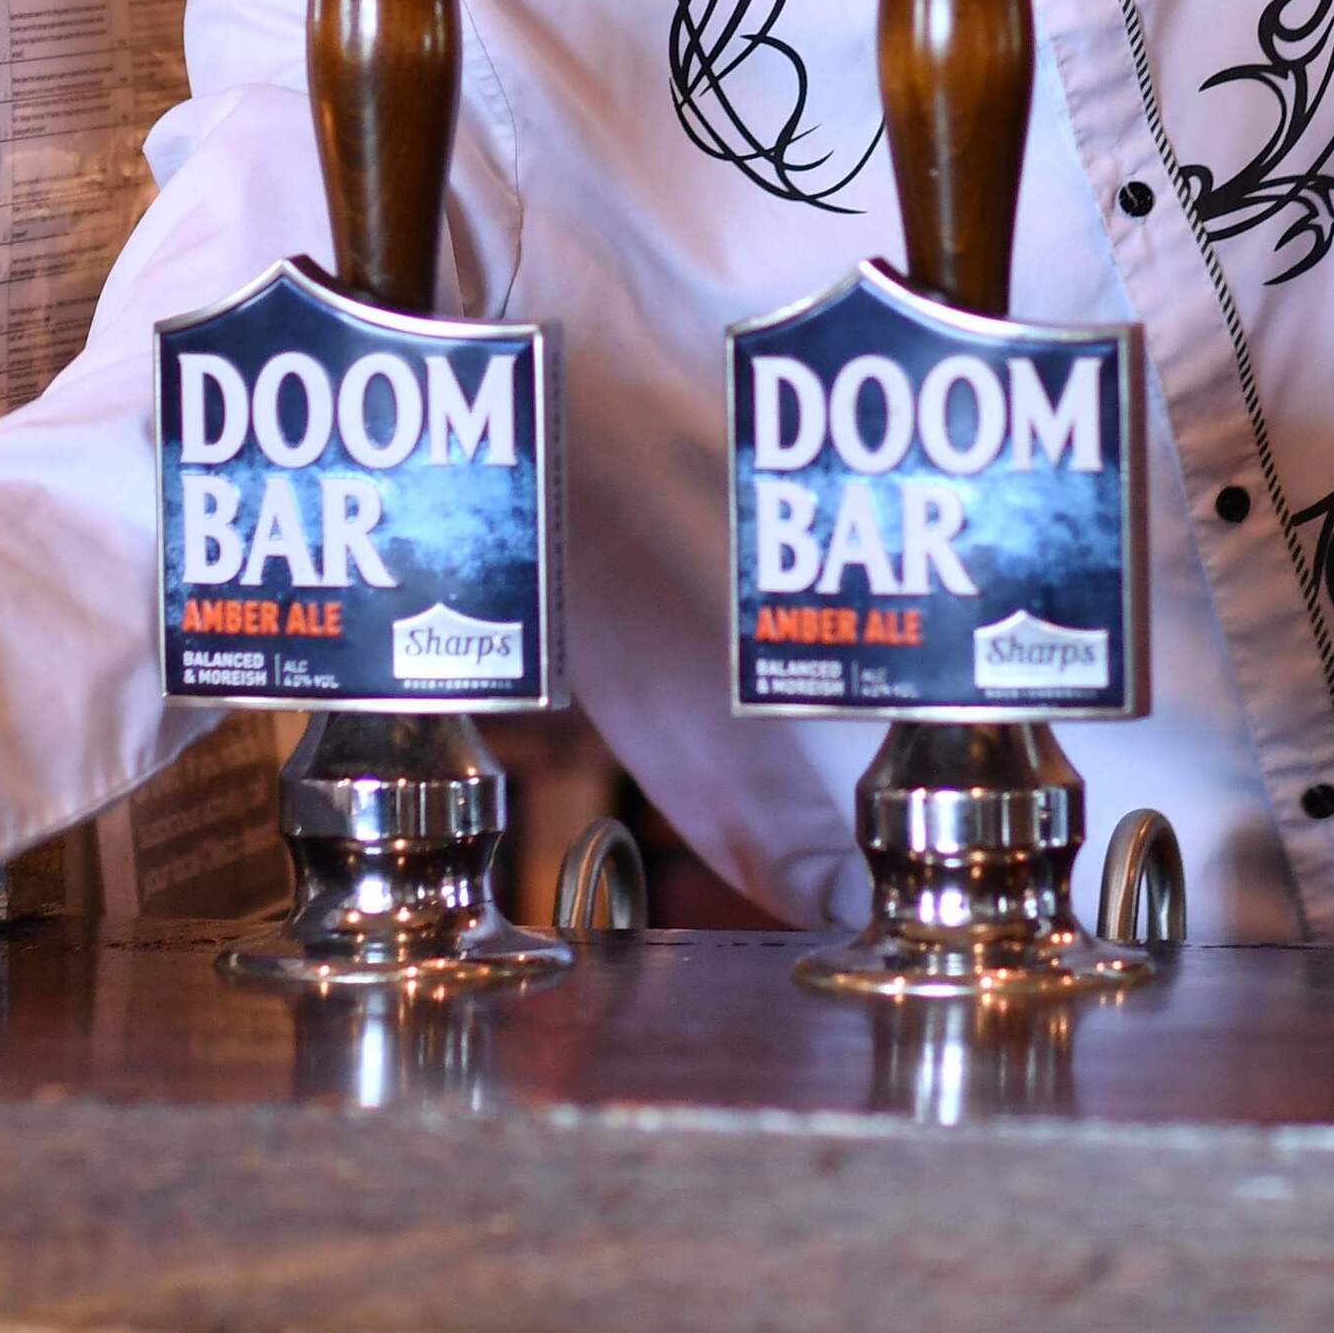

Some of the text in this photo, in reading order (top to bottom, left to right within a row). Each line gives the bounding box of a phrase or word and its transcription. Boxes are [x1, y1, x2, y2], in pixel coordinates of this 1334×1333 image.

[177, 351, 518, 468] DOOM
[751, 353, 1103, 475] DOOM
[180, 474, 399, 589] BAR
[753, 479, 979, 596] BAR
[182, 597, 342, 637] AMBER ALE
[755, 606, 923, 646] AMBER ALE
[182, 650, 265, 669] BALANCED
[198, 669, 268, 686] MOREISH
